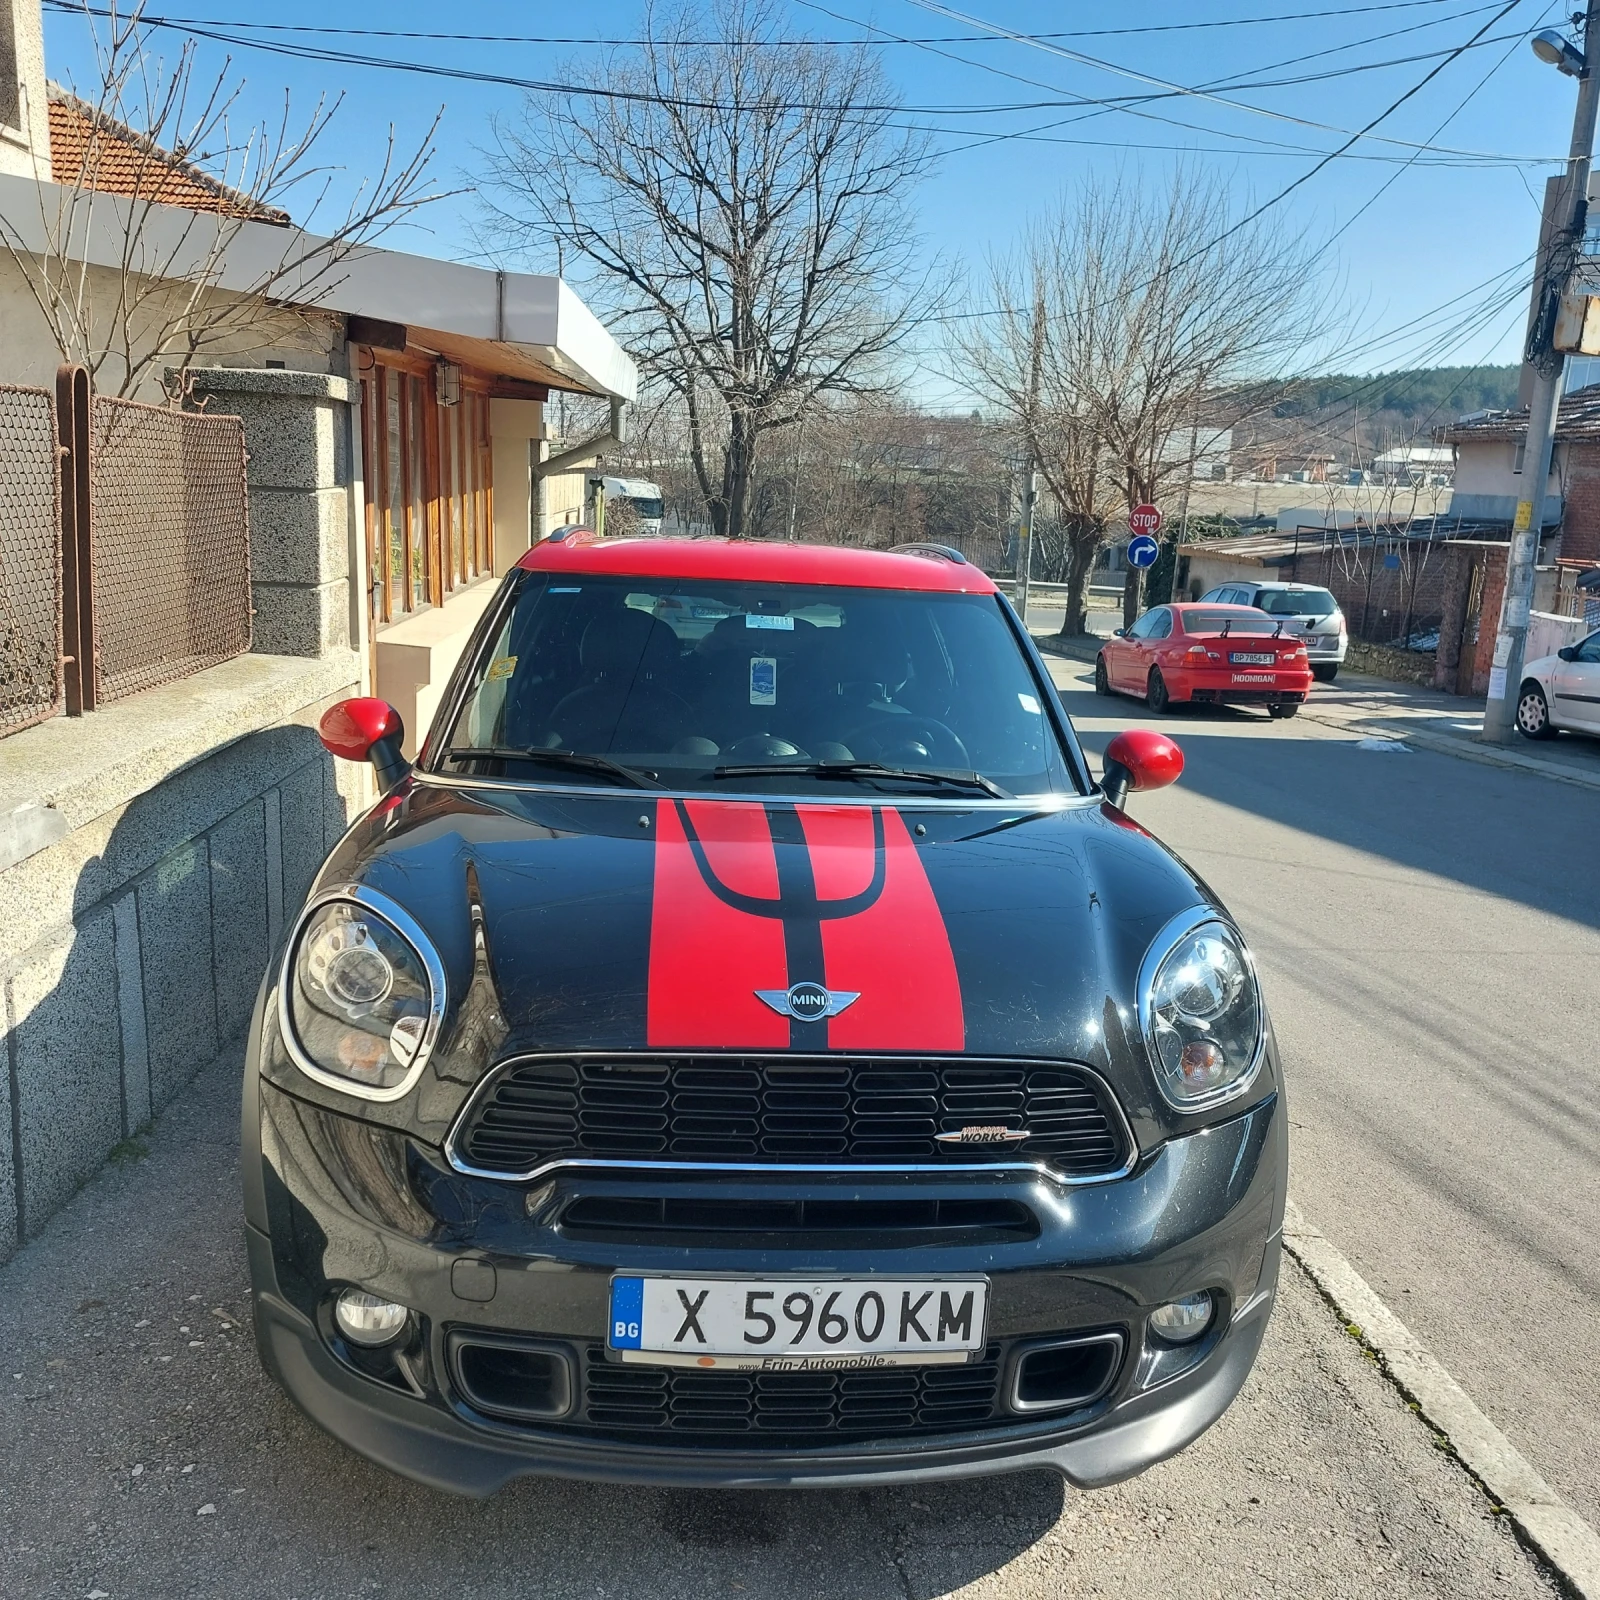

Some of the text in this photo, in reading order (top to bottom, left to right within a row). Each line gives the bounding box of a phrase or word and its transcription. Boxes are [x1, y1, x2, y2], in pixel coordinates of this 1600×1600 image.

[1133, 514, 1158, 527] STOP
[1246, 654, 1262, 663] 7856
[793, 995, 825, 1005] MINI
[961, 1132, 1006, 1142] WORKS
[673, 1289, 975, 1345] X 5960 KM
[614, 1322, 639, 1338] BG
